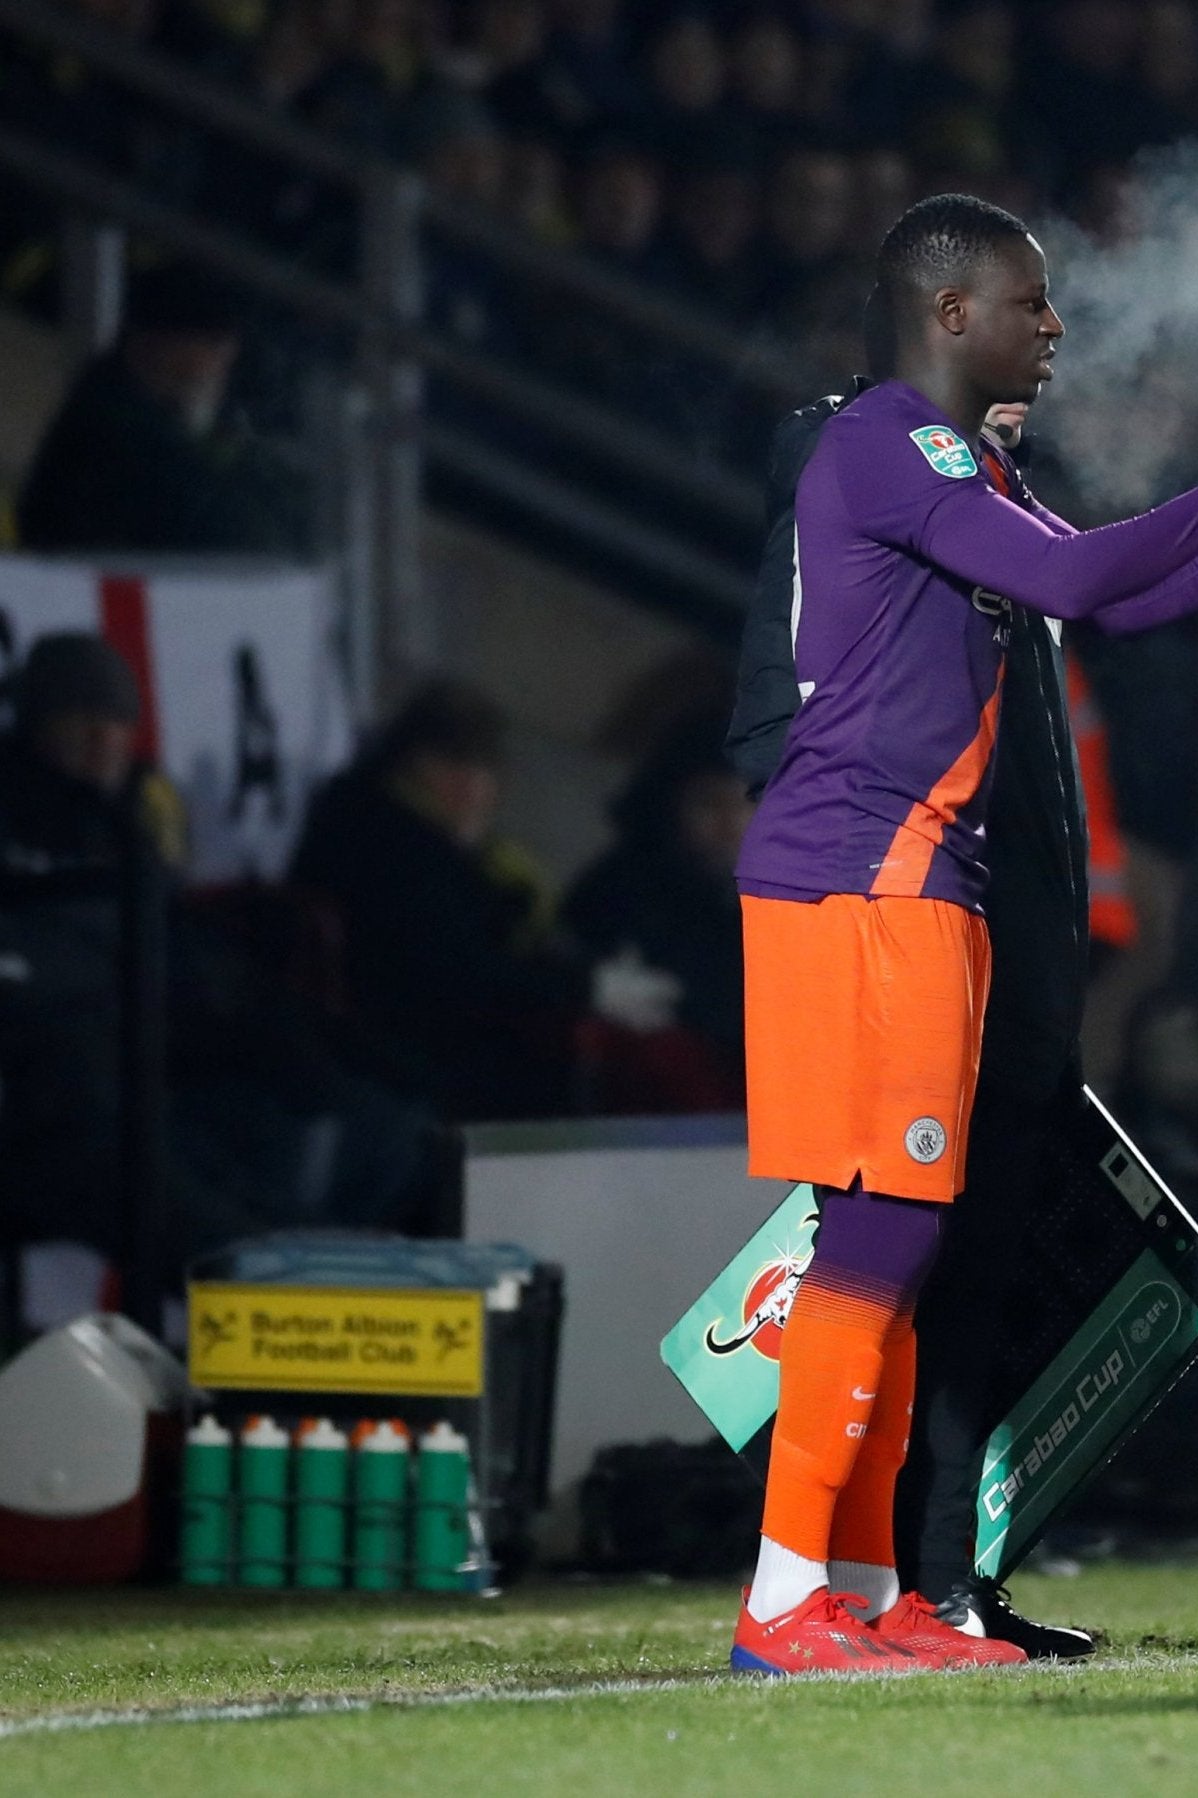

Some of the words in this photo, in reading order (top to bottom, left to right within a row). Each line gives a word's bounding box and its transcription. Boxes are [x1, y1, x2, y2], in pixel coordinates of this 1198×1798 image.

[251, 1312, 333, 1335] Burton
[342, 1314, 419, 1337] Albion
[252, 1338, 350, 1362] Football
[359, 1341, 417, 1364] Club
[983, 1403, 1081, 1522] Carabao
[1076, 1350, 1125, 1412] Cup
[1146, 1299, 1169, 1324] EFL
